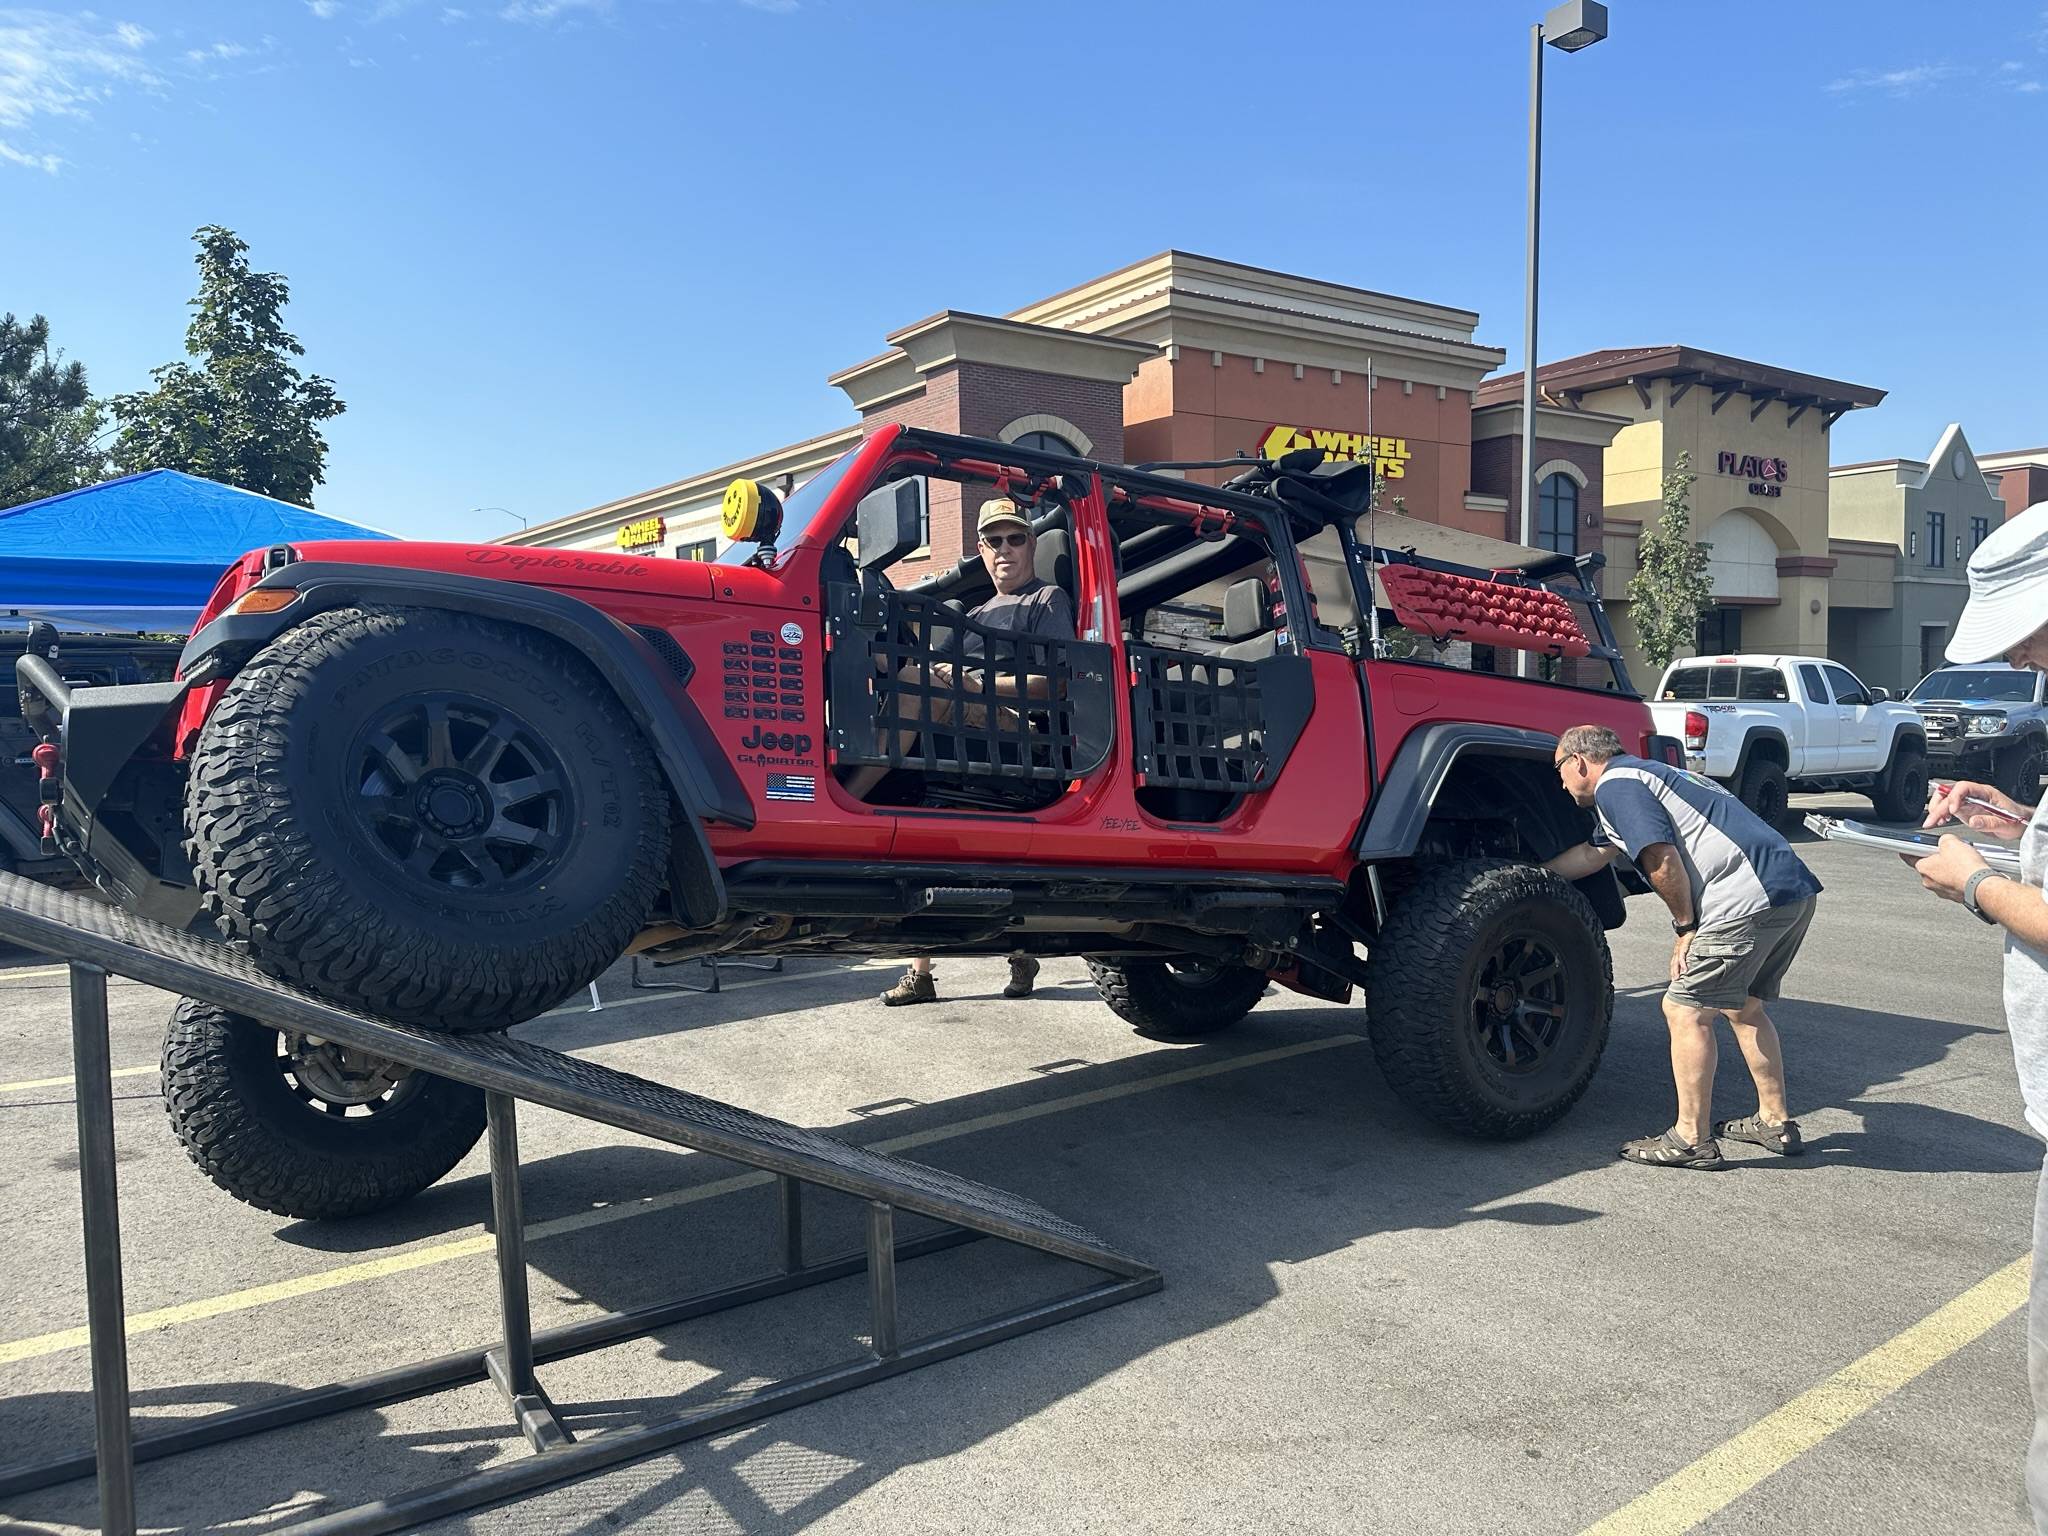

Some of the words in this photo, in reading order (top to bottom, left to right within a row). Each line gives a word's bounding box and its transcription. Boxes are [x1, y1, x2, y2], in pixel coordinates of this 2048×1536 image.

[1310, 429, 1412, 460] WHEEL
[616, 526, 630, 548] 4
[629, 518, 660, 535] WHEEL
[630, 530, 659, 546] PARTS
[465, 549, 649, 577] Deplorable
[742, 725, 812, 756] Jeep
